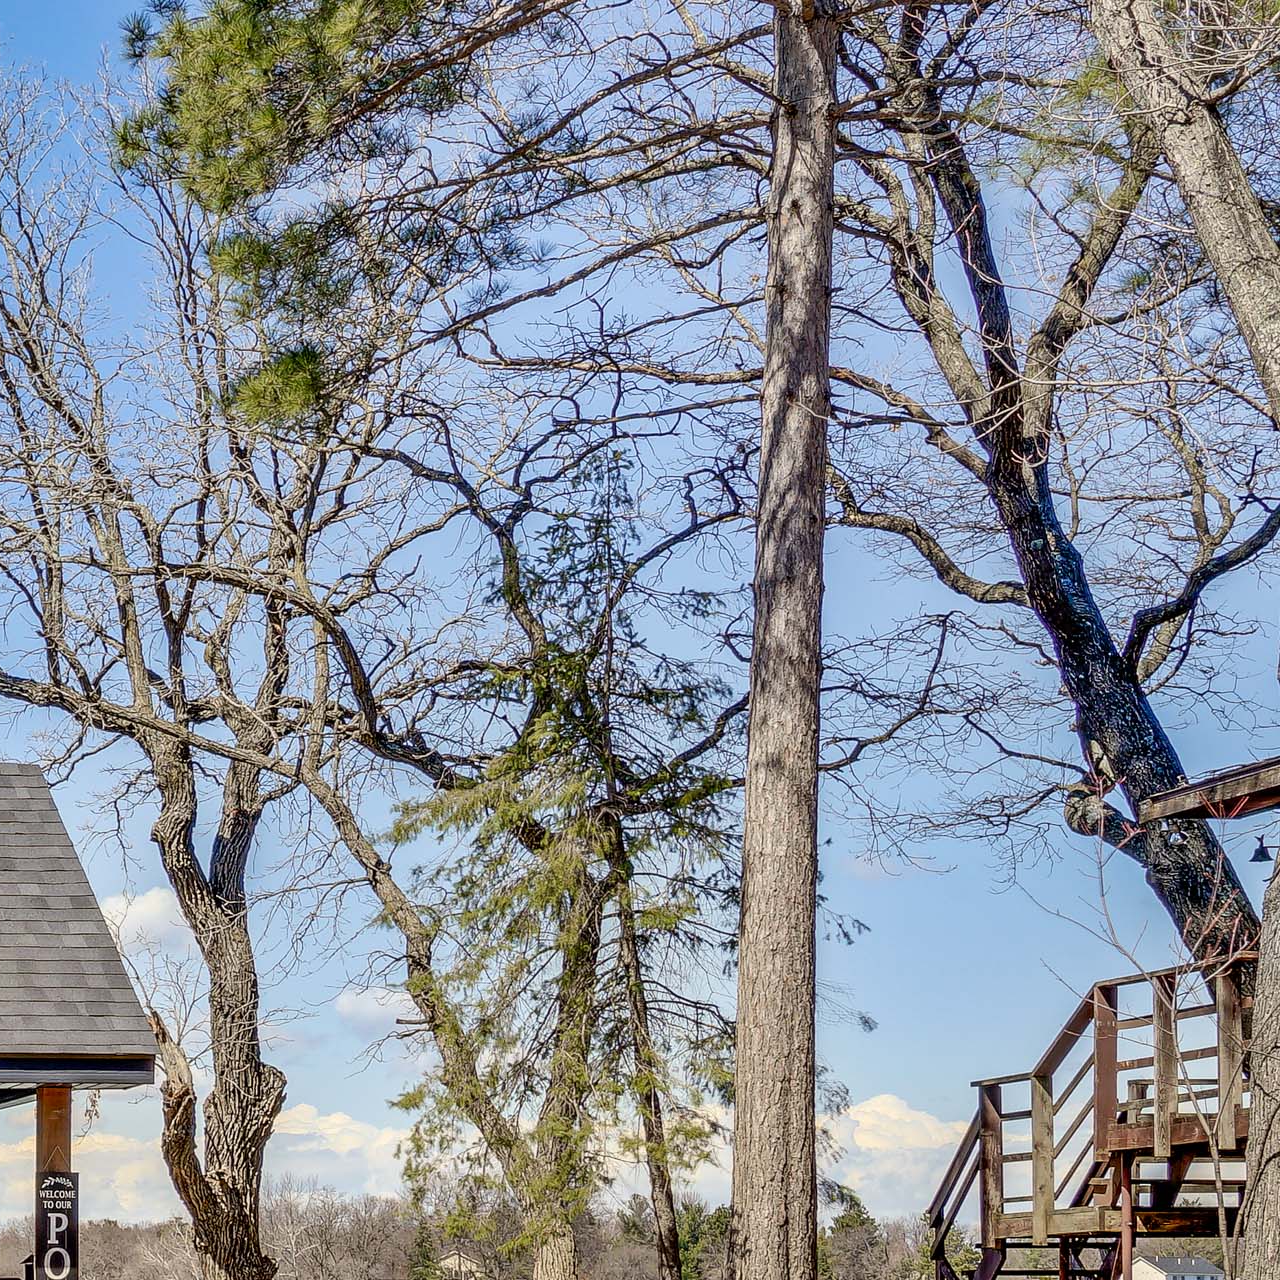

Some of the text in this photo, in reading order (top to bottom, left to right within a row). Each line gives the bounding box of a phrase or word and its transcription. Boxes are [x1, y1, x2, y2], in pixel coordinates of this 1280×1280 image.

[39, 1189, 77, 1199] WELCOME
[42, 1200, 73, 1210] TO OUR
